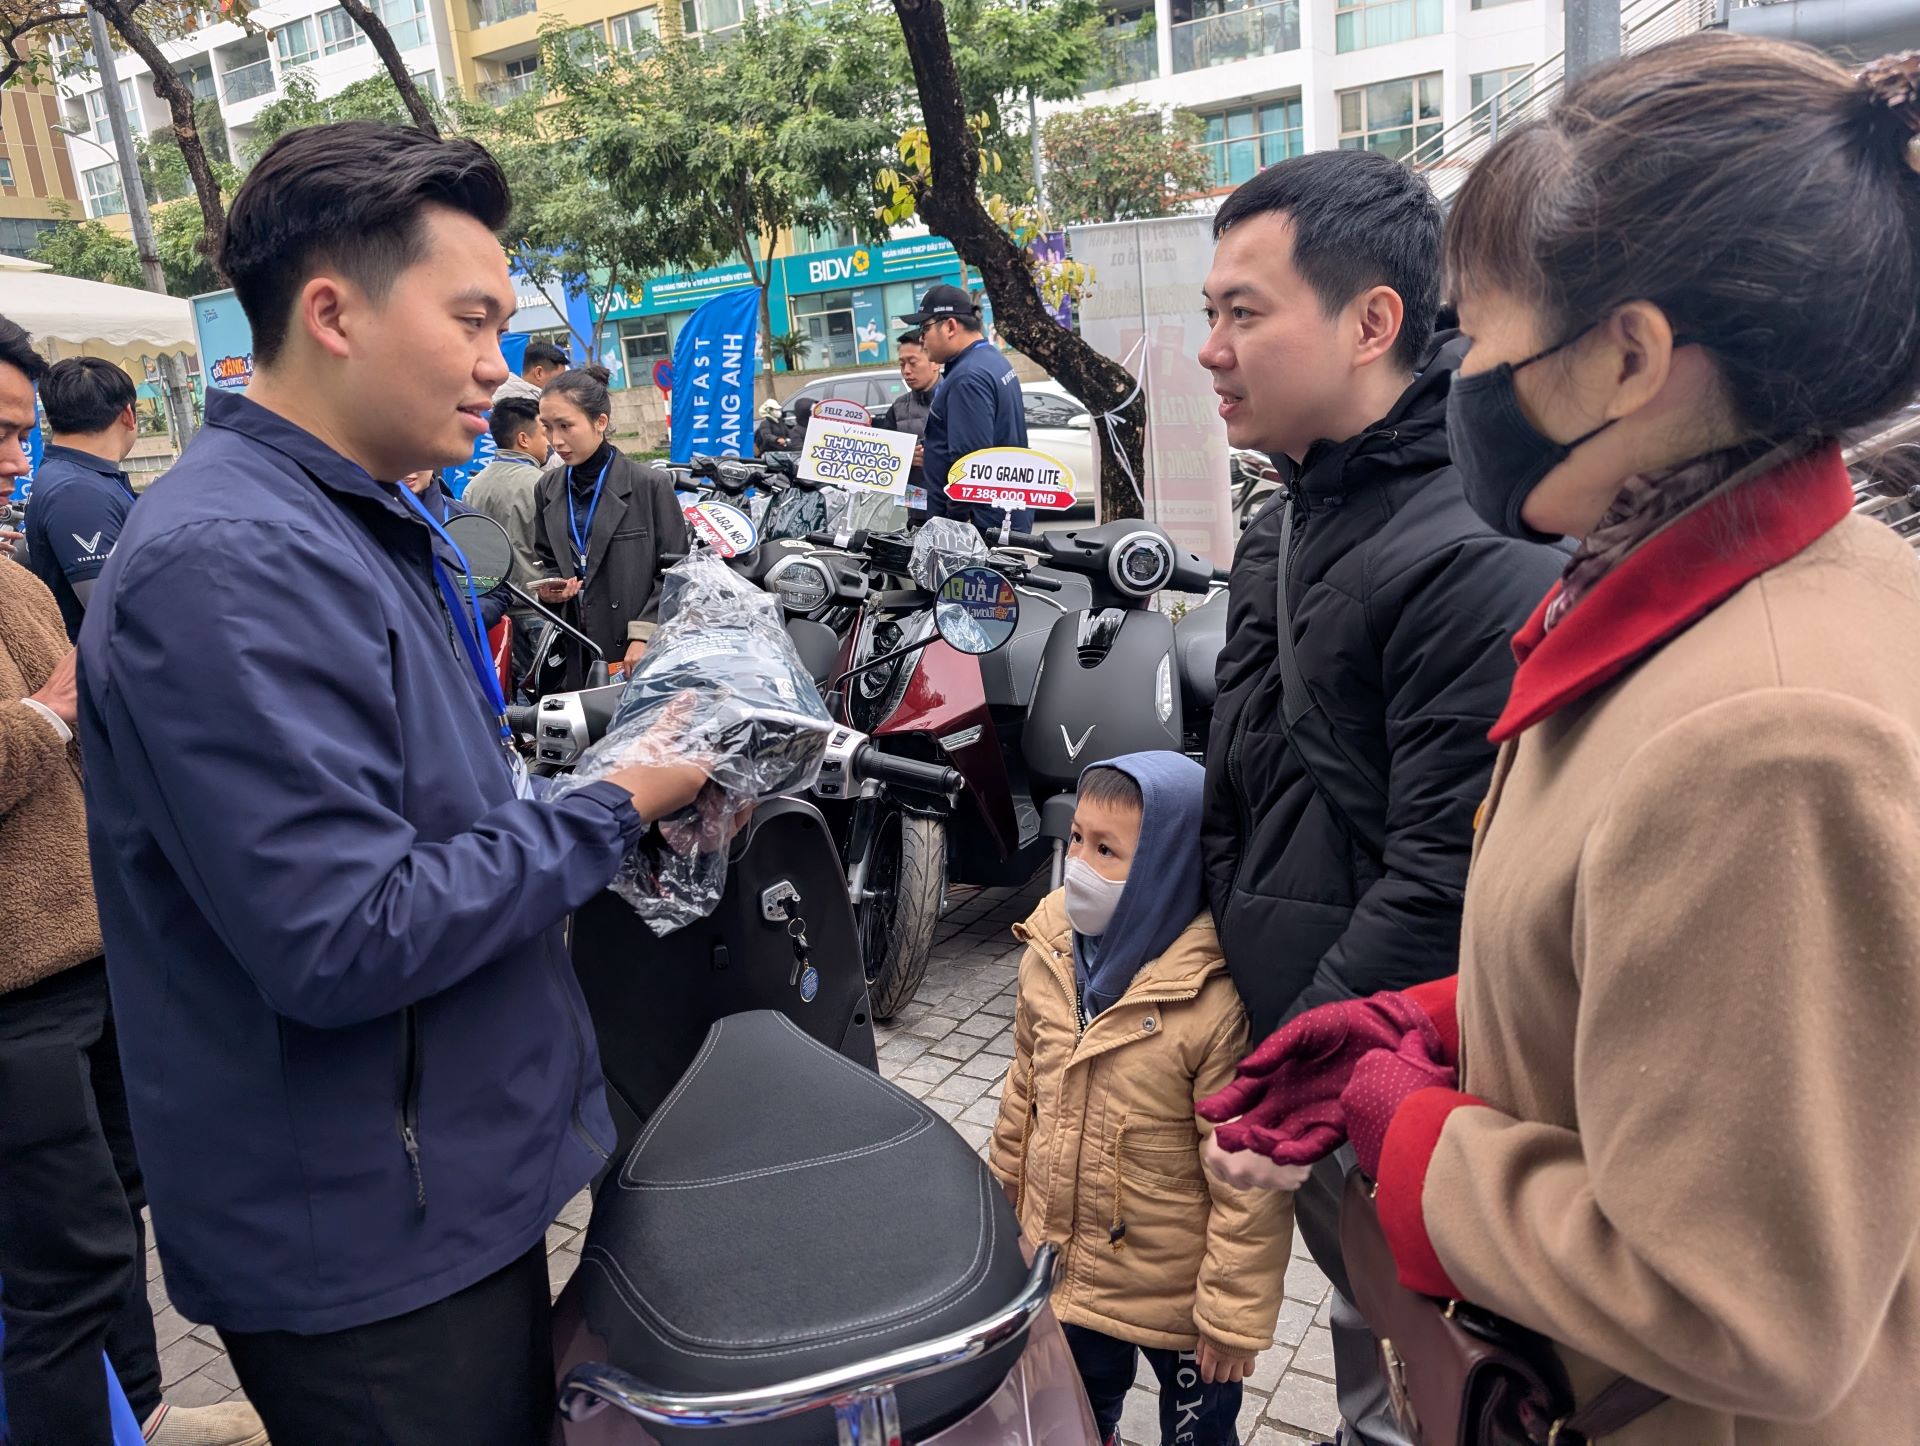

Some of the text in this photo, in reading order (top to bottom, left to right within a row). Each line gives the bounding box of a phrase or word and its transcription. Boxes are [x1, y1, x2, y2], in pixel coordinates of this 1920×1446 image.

[809, 256, 853, 283] BIDV
[525, 292, 552, 308] Living
[721, 334, 743, 387] ANH
[824, 406, 863, 420] FELIZ 2025
[824, 434, 890, 457] THU MUA
[811, 446, 901, 472] XE XĂNG CŨ
[817, 461, 894, 487] GIÁ CAO
[970, 464, 1060, 485] EVO GRAND LITE
[961, 487, 1056, 504] 17.388.000 VNĐ
[707, 507, 748, 545] KLARA NEO
